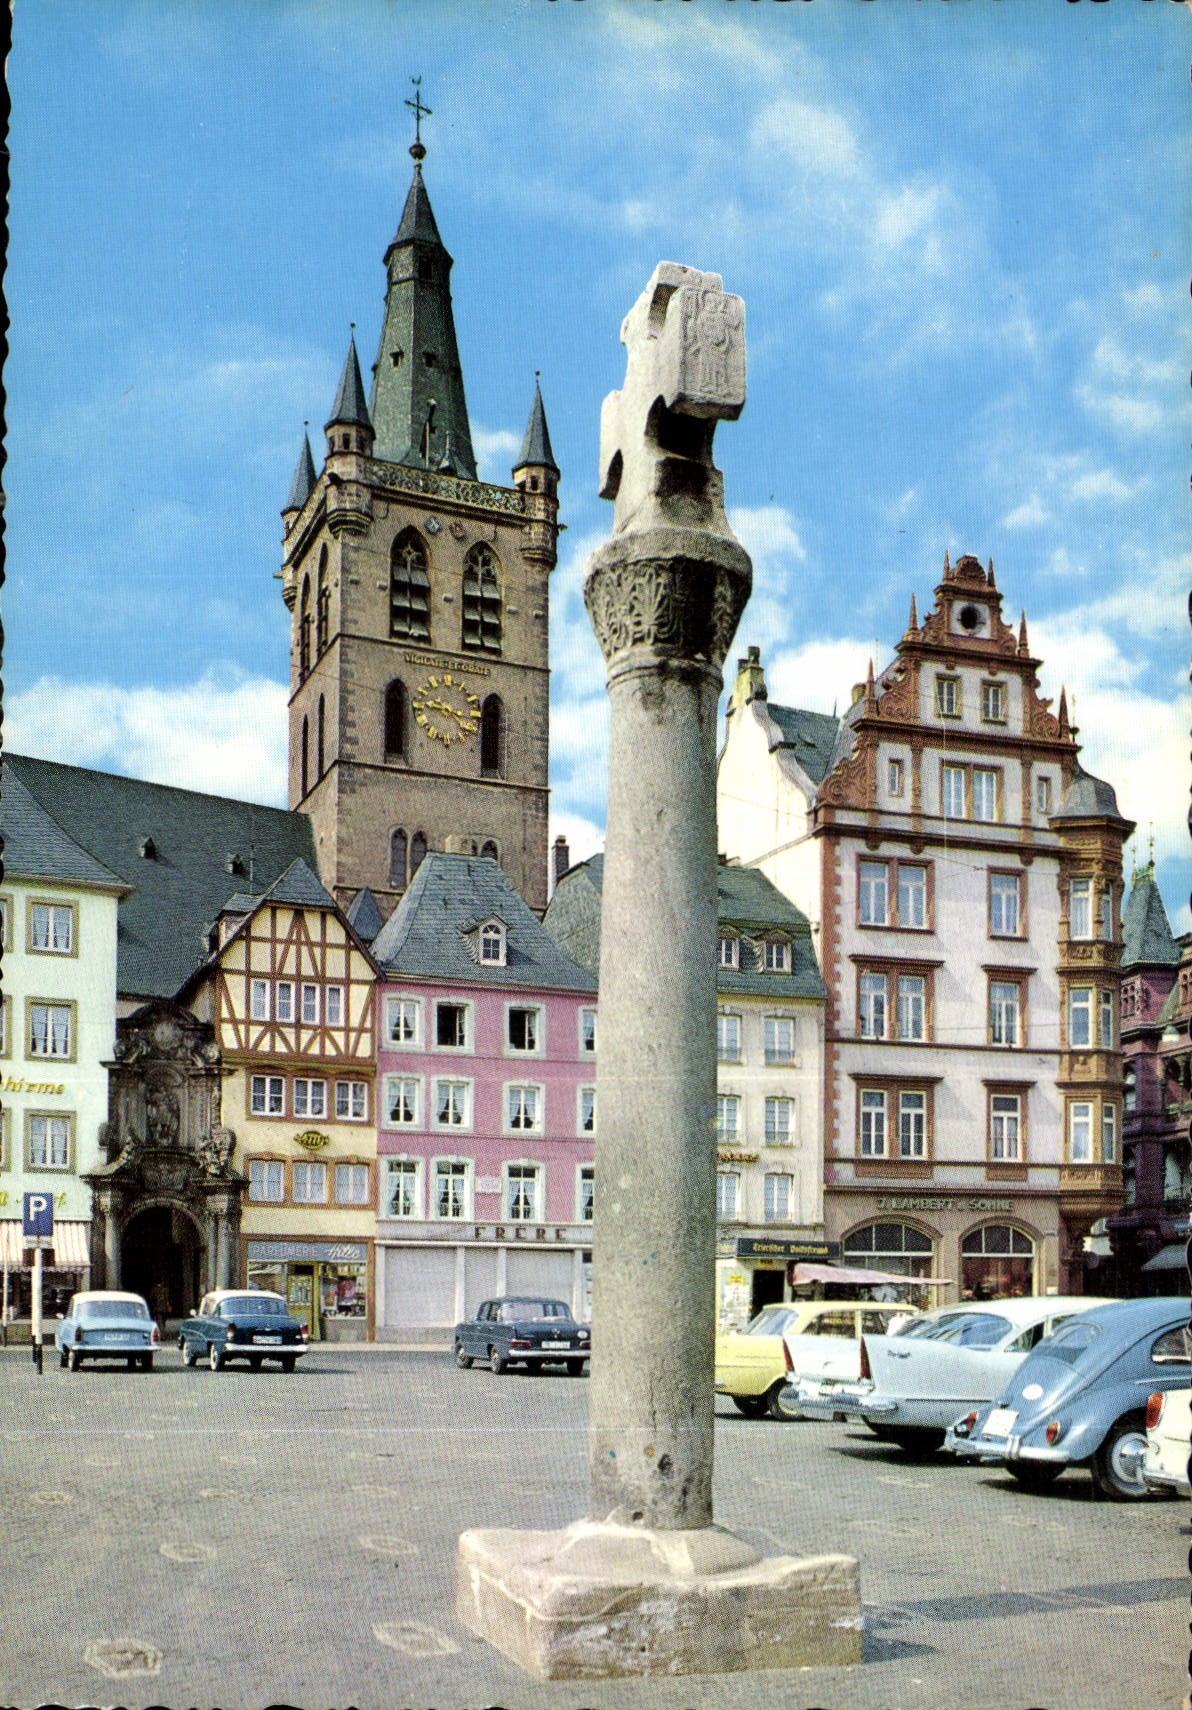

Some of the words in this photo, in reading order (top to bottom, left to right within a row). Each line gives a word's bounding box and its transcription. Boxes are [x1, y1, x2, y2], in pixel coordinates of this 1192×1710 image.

[0, 1075, 64, 1095] hirme
[29, 1195, 47, 1222] P
[891, 1198, 955, 1210] LAMBERT
